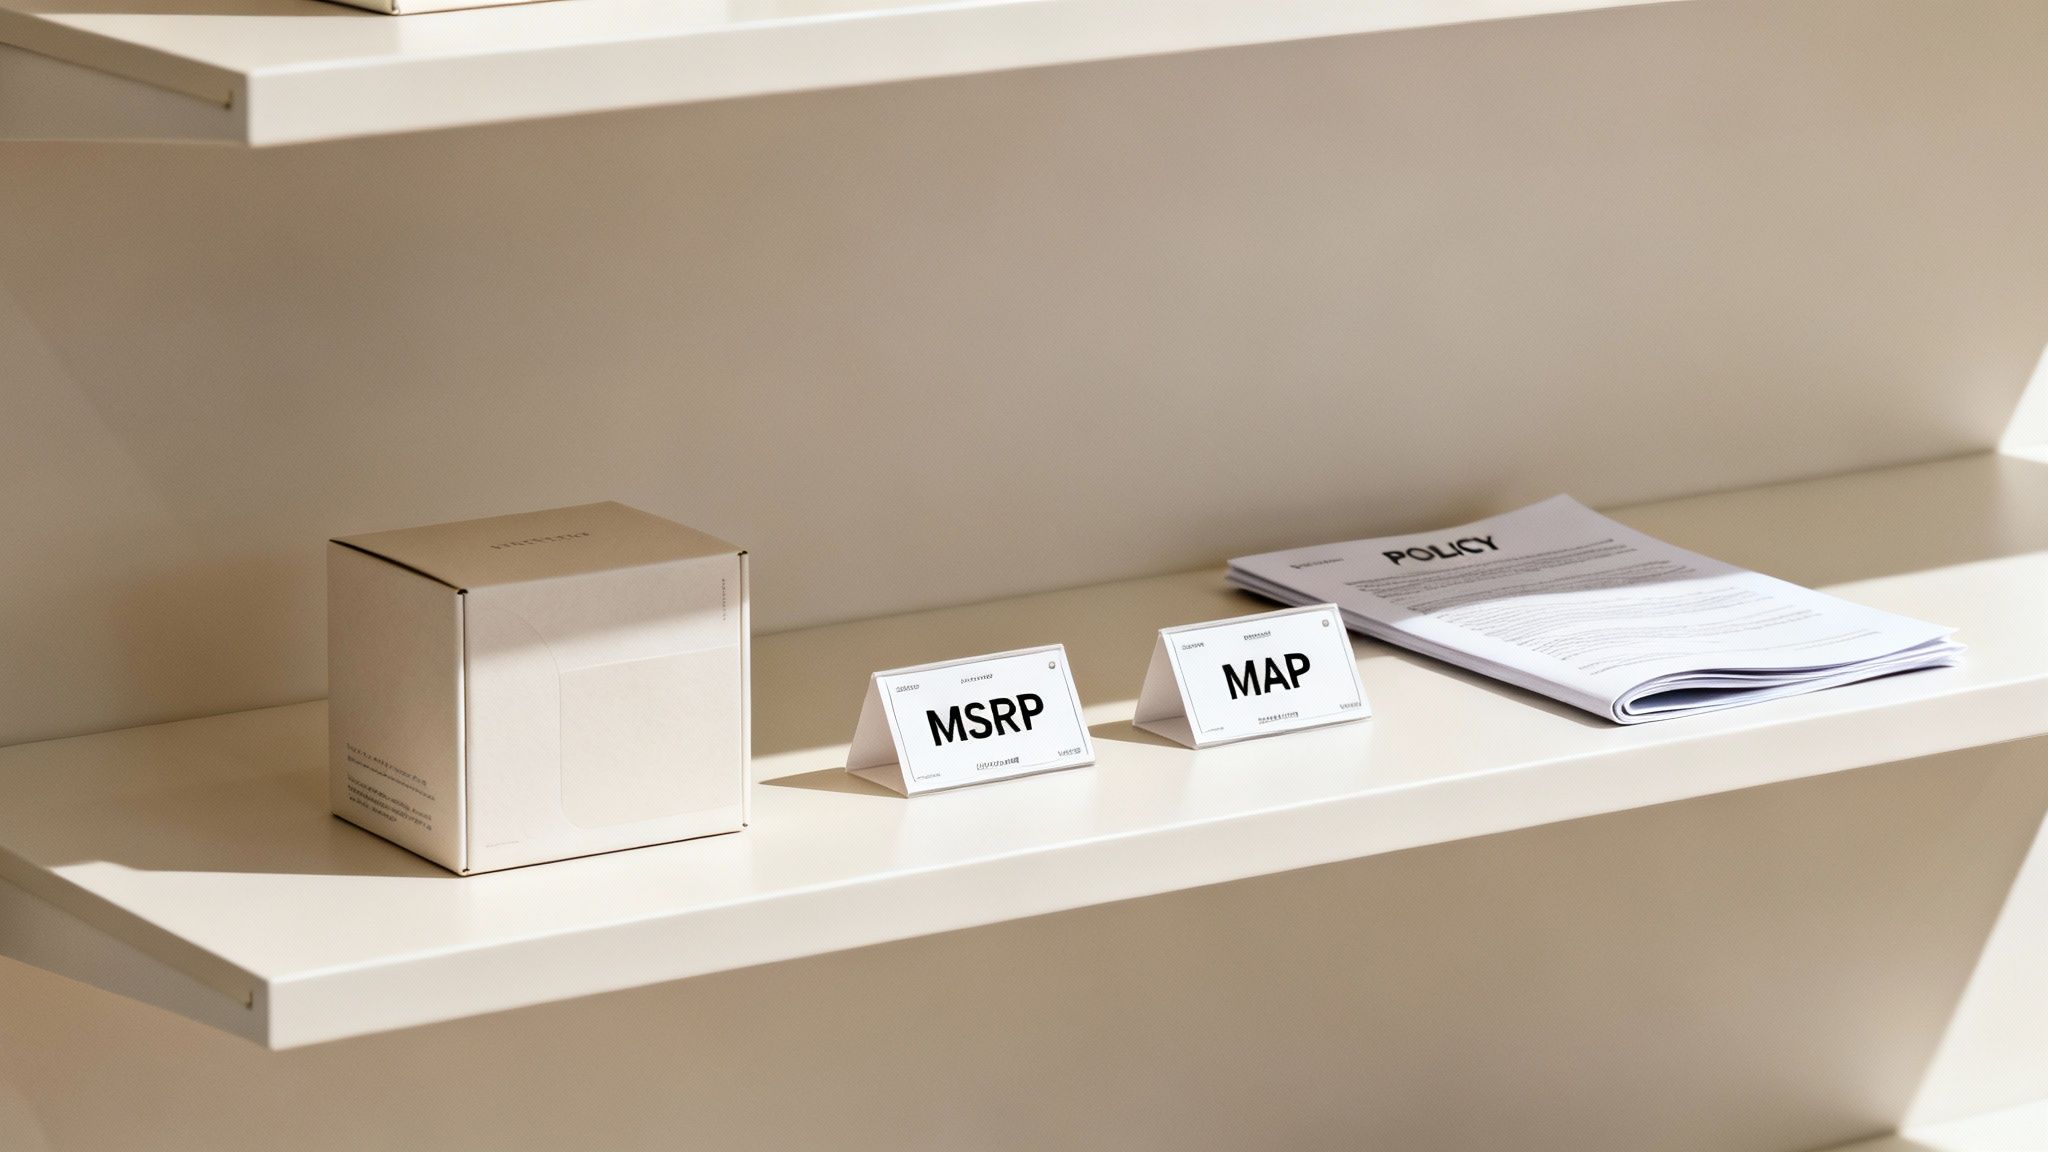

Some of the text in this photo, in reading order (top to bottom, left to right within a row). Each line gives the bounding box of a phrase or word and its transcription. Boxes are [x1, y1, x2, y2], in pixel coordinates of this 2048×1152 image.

[1382, 535, 1499, 566] POLICY
[1222, 652, 1311, 700] MAP
[926, 693, 1044, 747] MSRP
